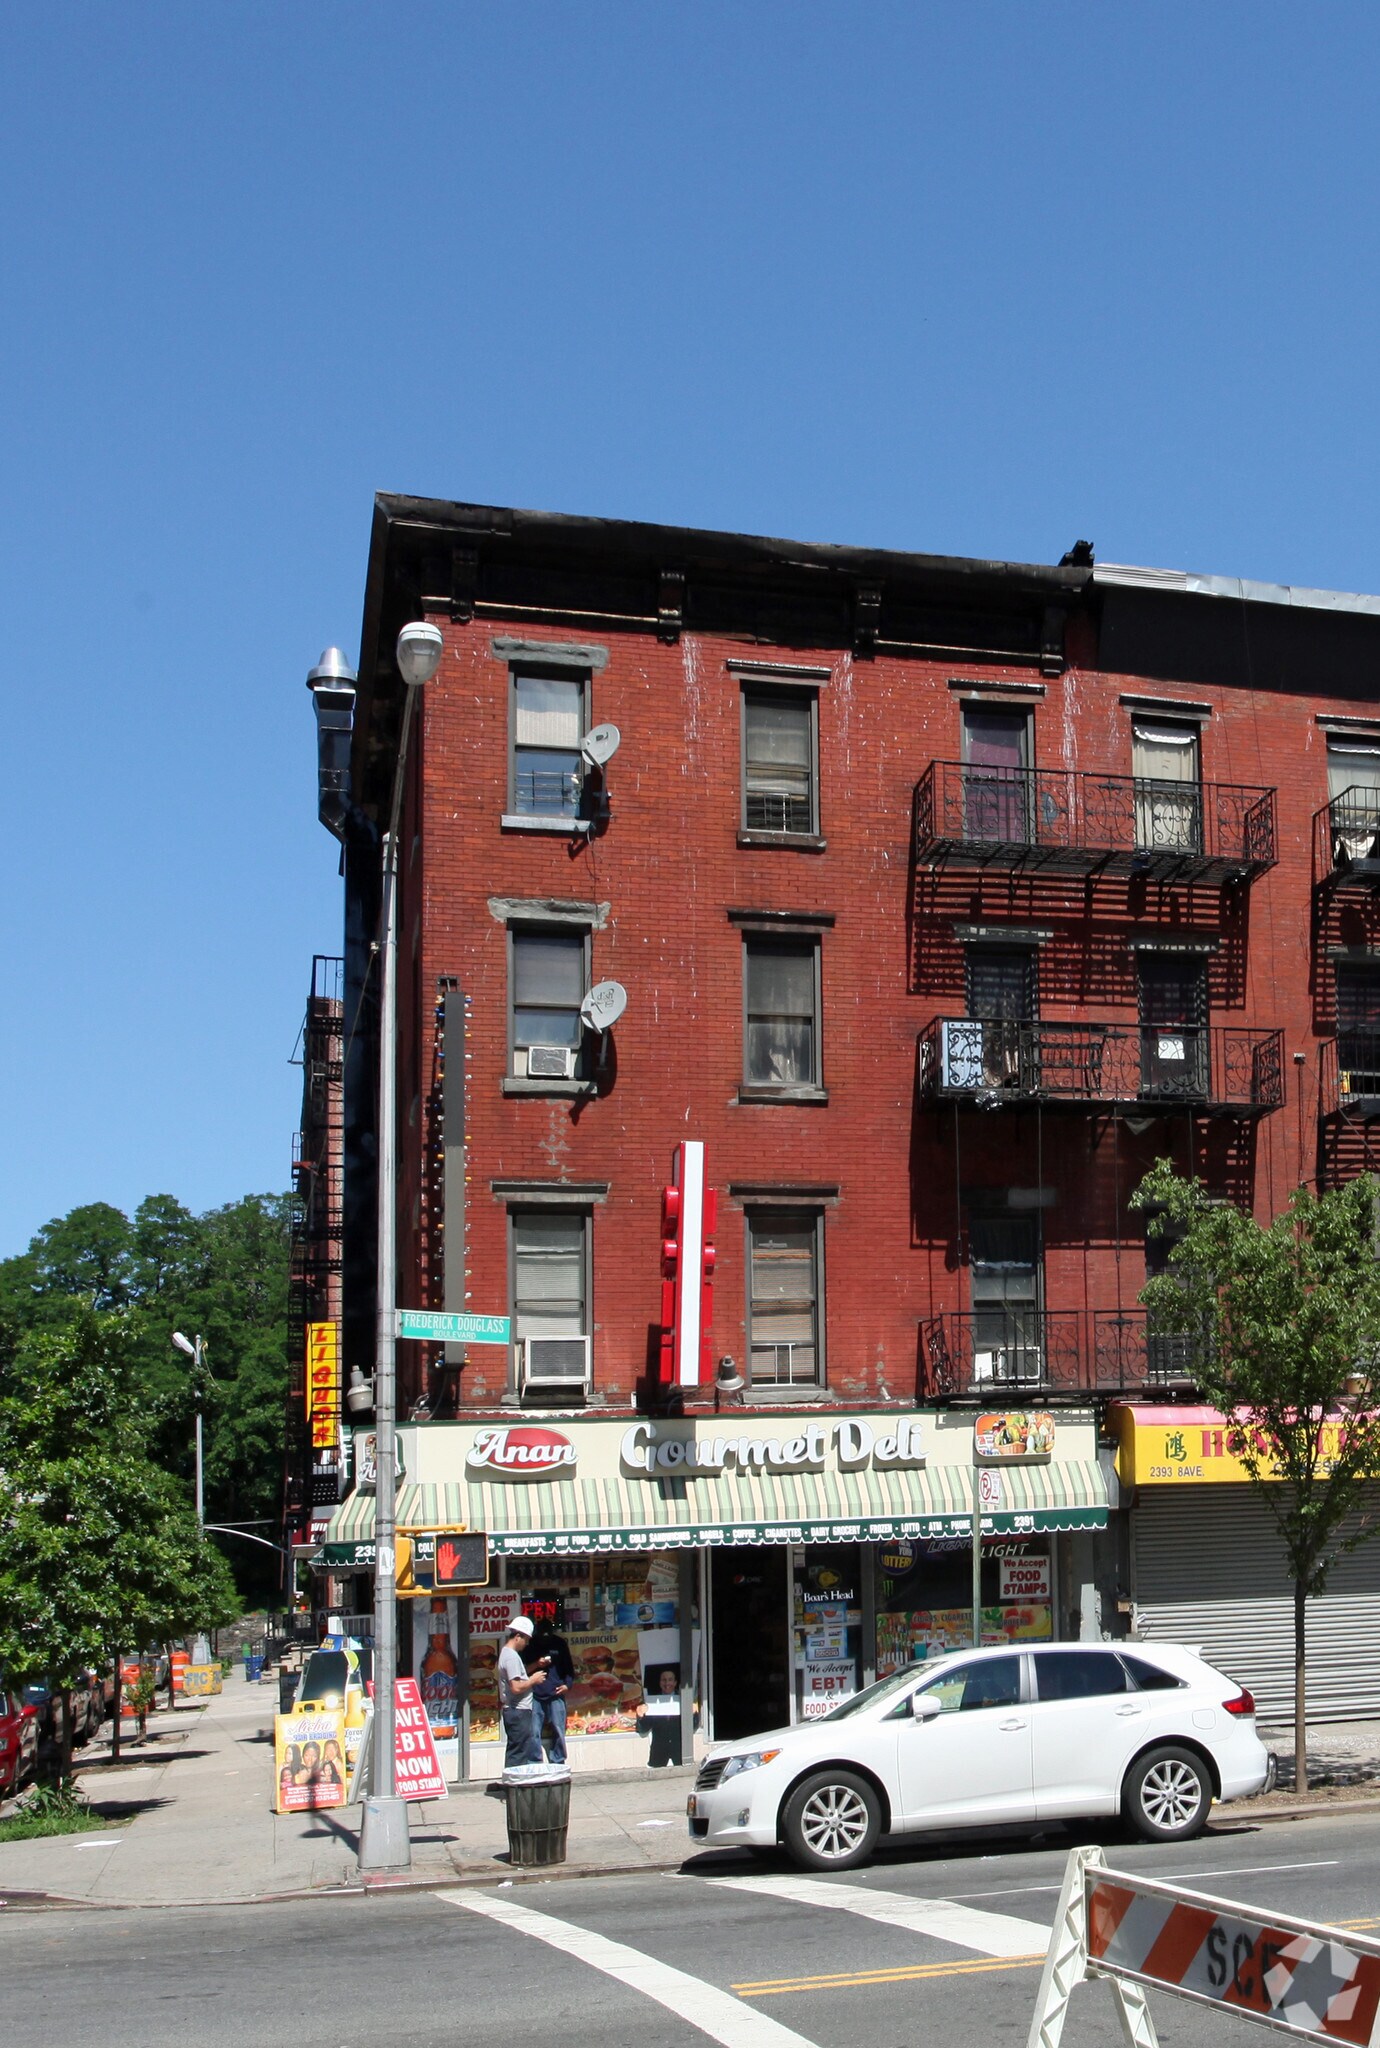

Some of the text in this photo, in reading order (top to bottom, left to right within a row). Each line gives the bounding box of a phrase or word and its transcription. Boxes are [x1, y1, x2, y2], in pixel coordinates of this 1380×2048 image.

[404, 1314, 504, 1333] FREDERICK DOUGLASS
[433, 1330, 476, 1339] BOULEVARD
[313, 1326, 332, 1443] LIQUOR
[467, 1428, 577, 1465] Anan
[621, 1422, 827, 1471] Gourmet
[833, 1417, 930, 1461] Deli
[1150, 1465, 1205, 1477] 2393 8AVE.
[1013, 1515, 1034, 1527] 2391
[504, 1536, 547, 1548] BREAKFASTS
[555, 1535, 570, 1546] HOT
[572, 1535, 590, 1545] FOOD
[598, 1534, 613, 1544] HOT
[629, 1533, 646, 1543] COLD
[649, 1531, 690, 1542] SANDWICHES
[699, 1529, 724, 1540] BAGELS
[732, 1529, 757, 1539] COFFEE
[764, 1527, 802, 1538] CIGARETTES
[810, 1525, 829, 1536] DAIRY
[832, 1524, 860, 1535] GROCERY
[869, 1523, 892, 1534] FROZEN
[901, 1522, 920, 1532] LOTTO
[928, 1521, 943, 1531] ATM
[951, 1519, 971, 1530] PHONE
[355, 1546, 376, 1557] 239
[980, 1543, 1029, 1558] LIGHT
[882, 1555, 913, 1568] LOTTERY
[1004, 1558, 1047, 1568] We Accept
[1009, 1570, 1041, 1582] FOOD
[804, 1589, 854, 1602] Boar's Head
[1003, 1583, 1047, 1595] STAMPS
[483, 1593, 517, 1604] Accept
[473, 1605, 510, 1619] FOOD
[521, 1602, 557, 1617] PEN
[469, 1620, 512, 1633] STAMP
[570, 1635, 618, 1645] SANDWICHES
[807, 1662, 854, 1674] We Accept
[812, 1676, 847, 1690] EBT
[397, 1684, 414, 1702] E
[421, 1679, 455, 1701] Coo
[825, 1690, 834, 1700] &
[426, 1699, 458, 1716] IGHT
[805, 1703, 827, 1714] FOOD
[395, 1706, 423, 1728] AVE
[396, 1756, 433, 1777] NOW
[398, 1777, 442, 1793] FOOD STAMP
